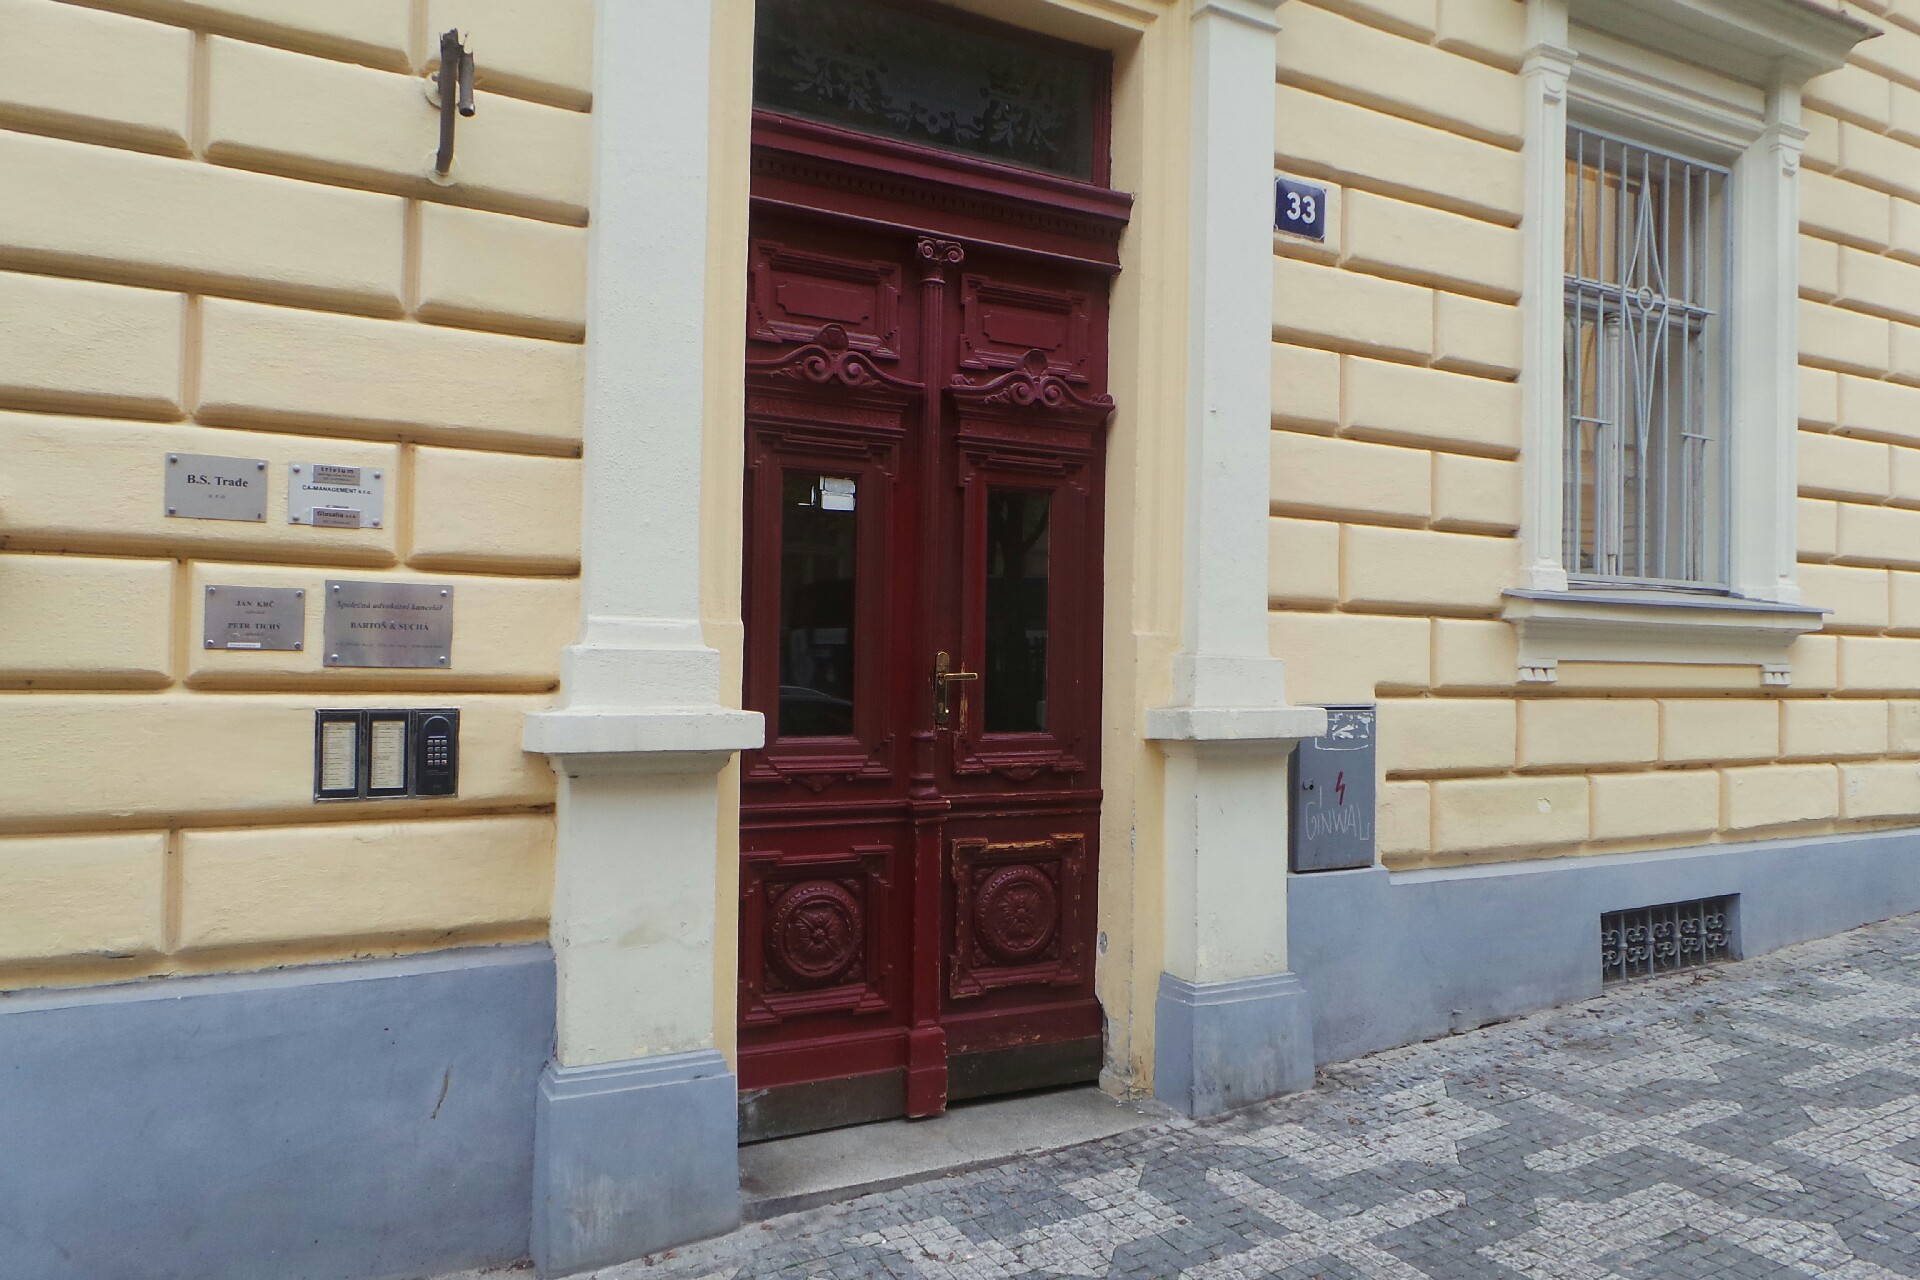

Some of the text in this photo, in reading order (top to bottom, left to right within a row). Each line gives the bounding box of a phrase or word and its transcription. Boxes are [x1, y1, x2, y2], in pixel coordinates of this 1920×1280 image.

[1286, 191, 1316, 224] 33
[320, 466, 354, 474] trivium
[187, 474, 249, 488] B.S. Trade
[302, 484, 357, 494] CA-MANAGEMENT
[256, 600, 275, 608] KRČ
[372, 601, 410, 610] advokátní
[255, 622, 281, 630] TICHÝ
[398, 623, 429, 631] SUCHÁ
